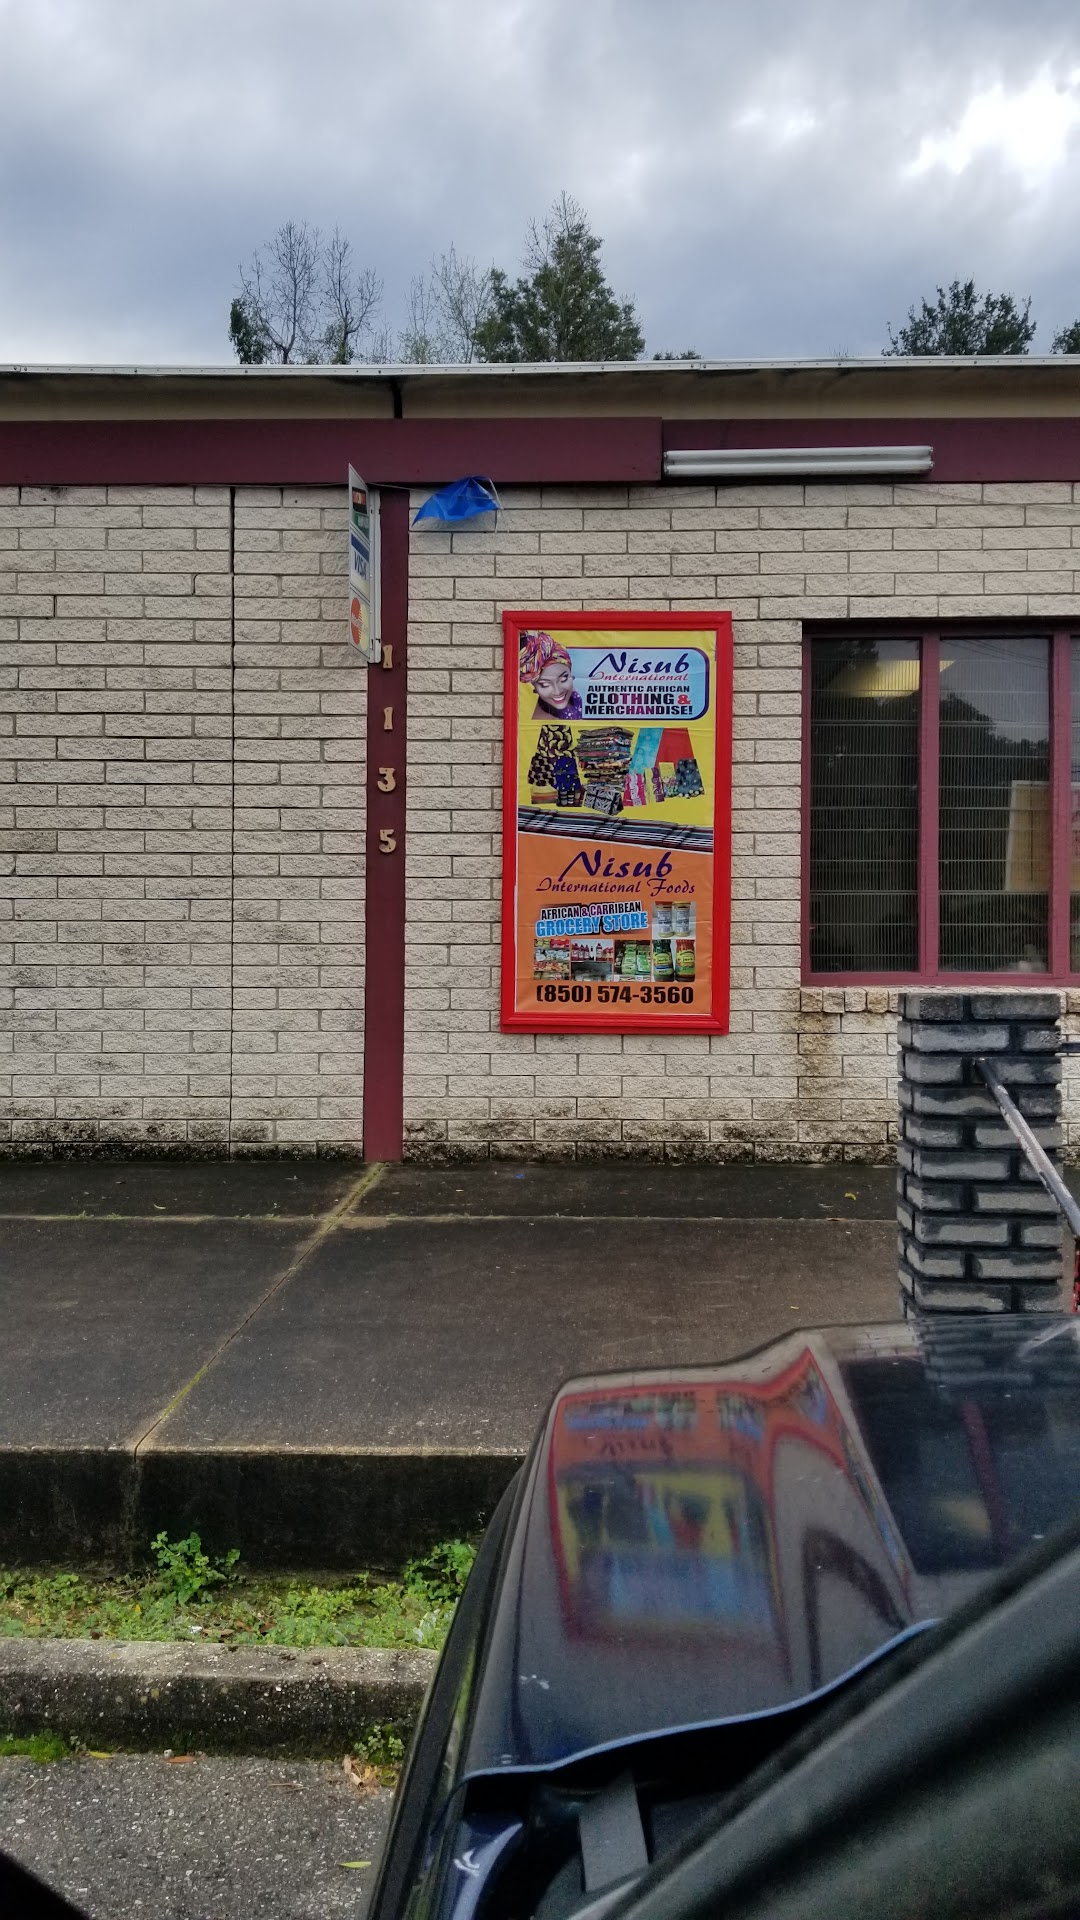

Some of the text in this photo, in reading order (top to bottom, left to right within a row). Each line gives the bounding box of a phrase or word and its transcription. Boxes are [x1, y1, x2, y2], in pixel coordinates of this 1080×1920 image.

[354, 551, 367, 580] VISA
[588, 651, 690, 678] Nisub
[590, 671, 689, 681] International
[586, 692, 691, 705] CLOTHING &
[587, 685, 690, 693] AUTHENTIC AFRICAN
[584, 705, 693, 715] MERCHANDISE!
[558, 849, 673, 883] Nisub
[536, 877, 696, 897] International Foods
[541, 900, 642, 921] AFRICAN & CARRIBEAN
[536, 916, 601, 937] GROCERY
[602, 912, 649, 932] STORE
[536, 985, 694, 1005] (850) 574-3560
